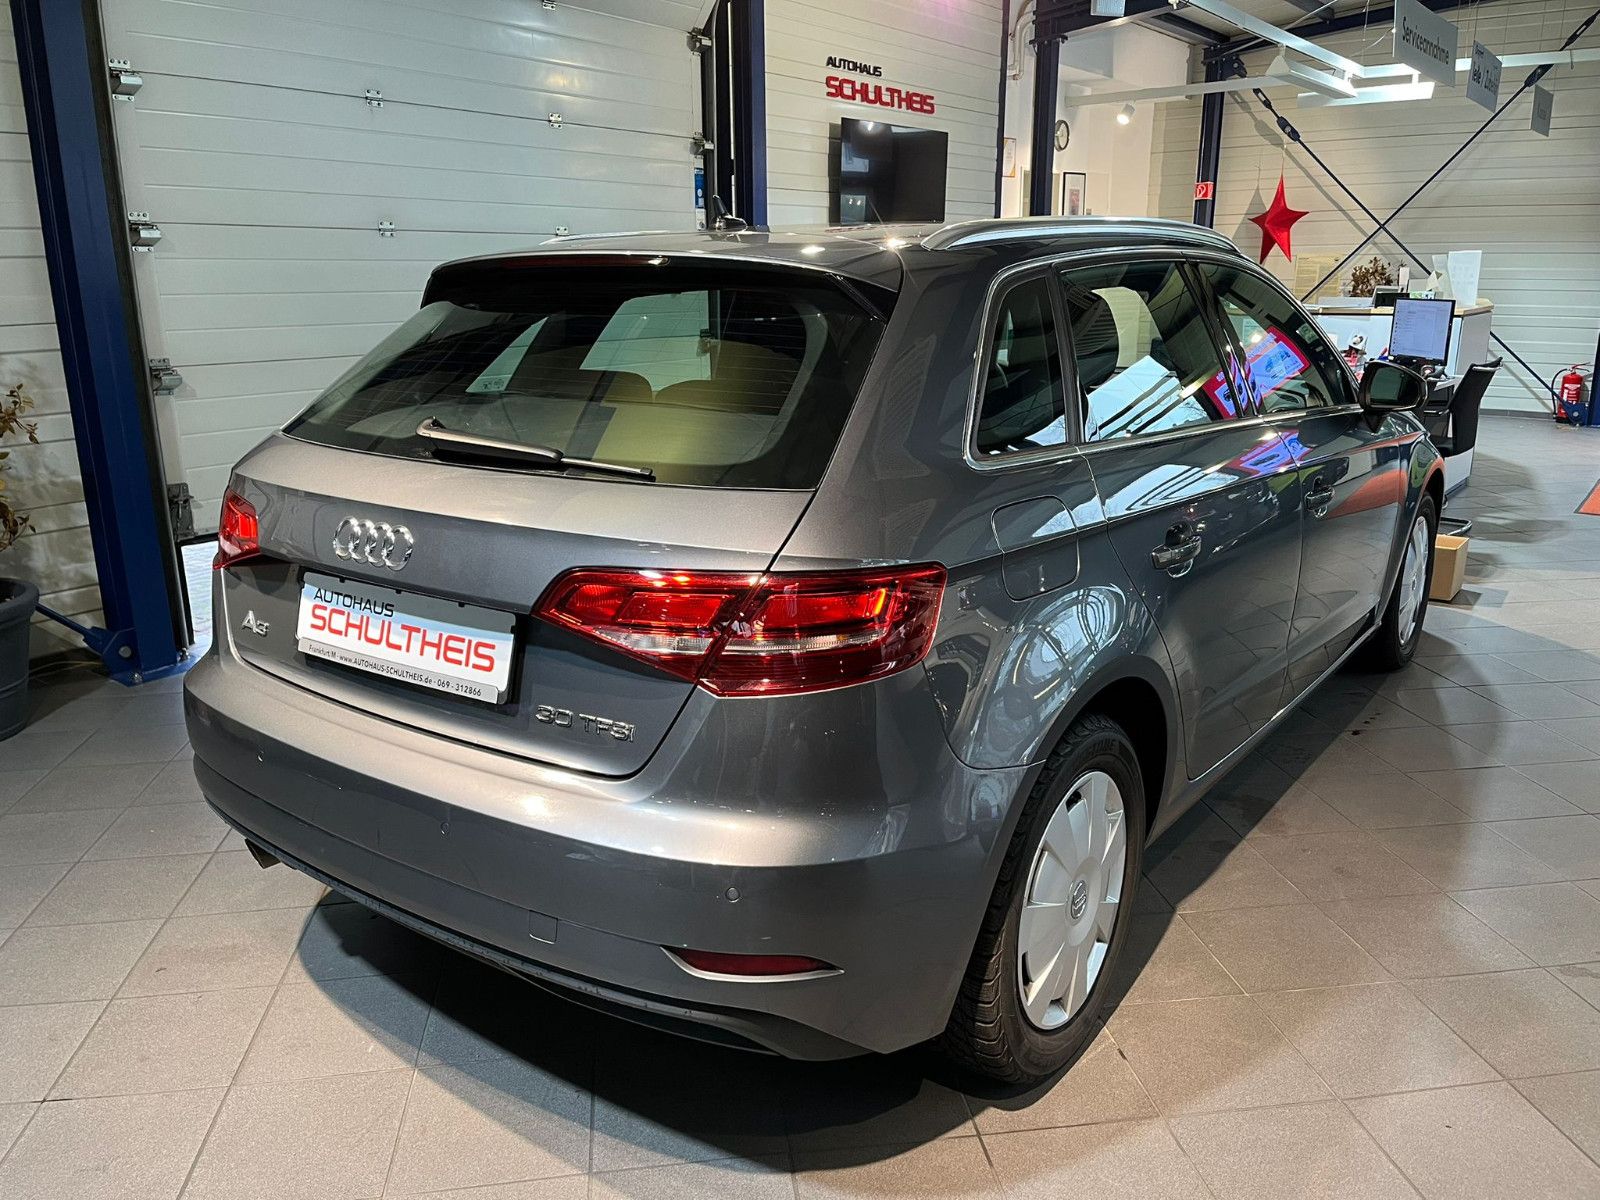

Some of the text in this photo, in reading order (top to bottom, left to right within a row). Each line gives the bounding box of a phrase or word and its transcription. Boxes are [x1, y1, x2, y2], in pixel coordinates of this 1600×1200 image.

[1402, 16, 1449, 65] Serviceannahme
[826, 56, 882, 77] AUTOHAUS
[825, 75, 935, 115] SCHULTHEIS
[313, 587, 395, 618] AUTOHAUS
[241, 610, 270, 637] A3
[310, 603, 496, 673] SCHULTHEIS
[437, 678, 451, 689] 069
[455, 683, 482, 697] 312866
[535, 704, 636, 743] 30 TFSI
